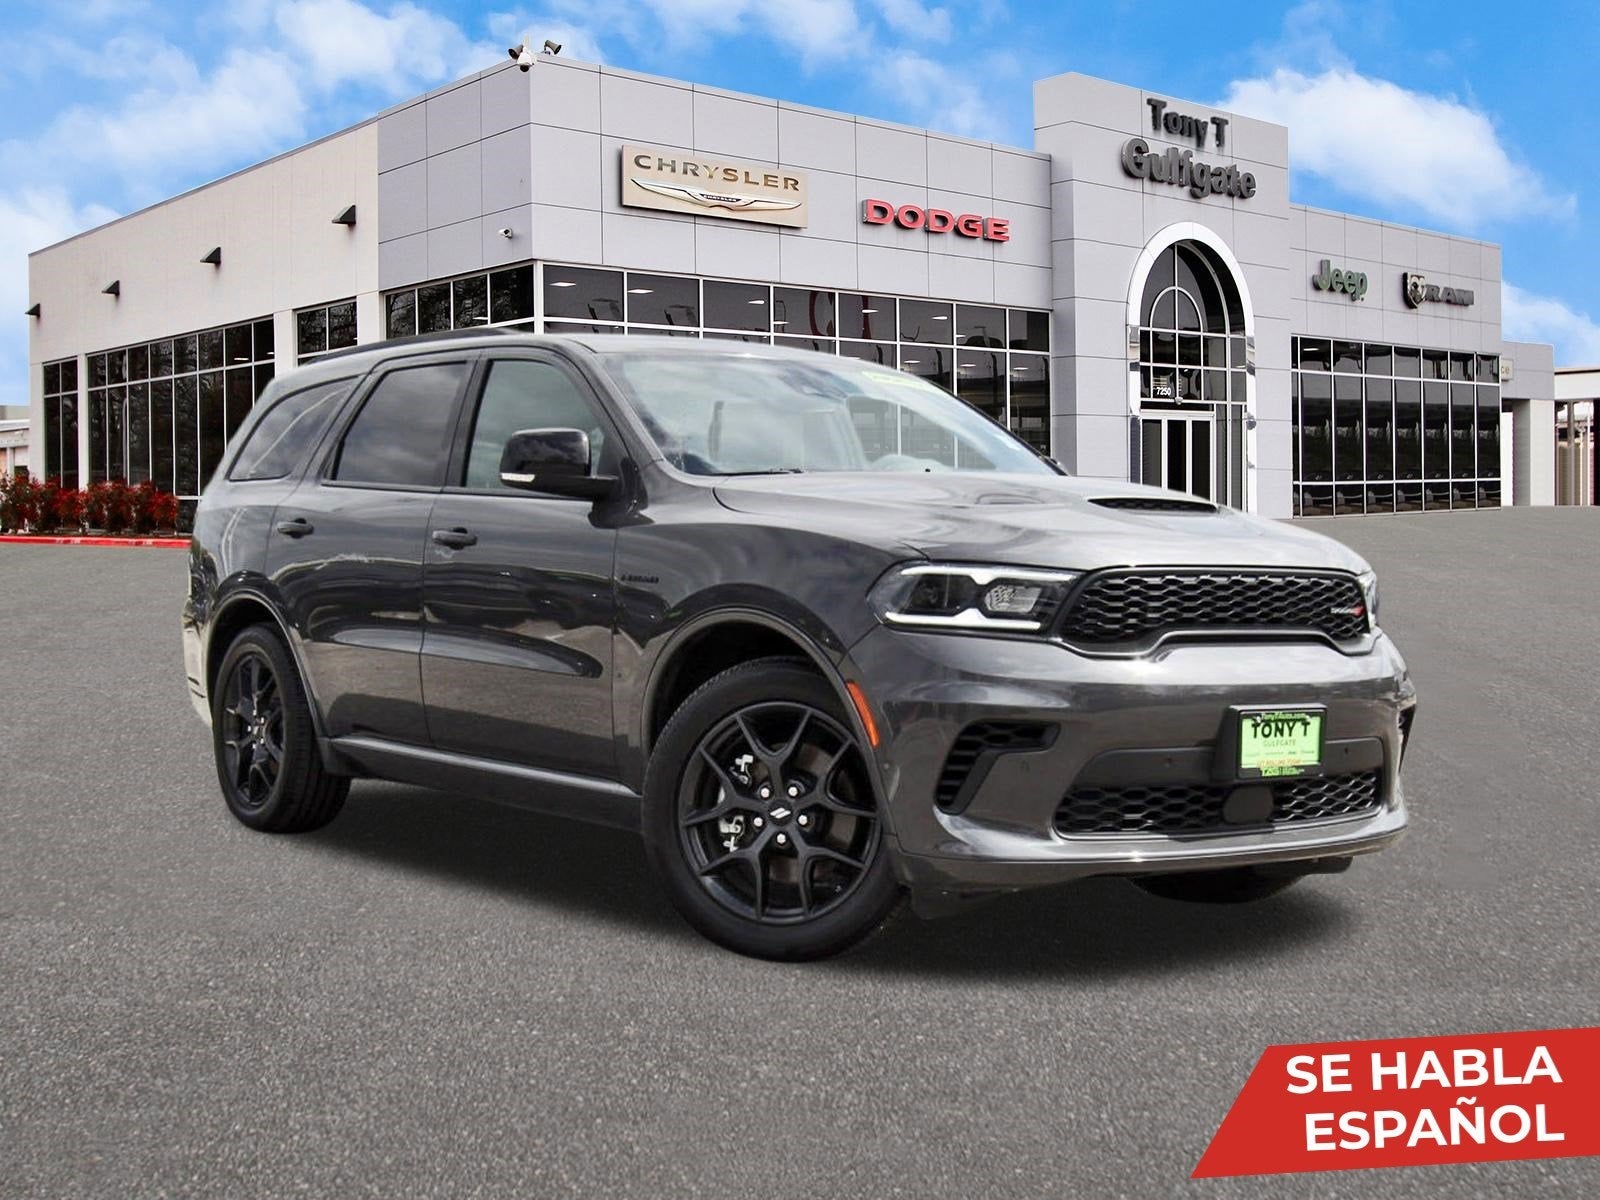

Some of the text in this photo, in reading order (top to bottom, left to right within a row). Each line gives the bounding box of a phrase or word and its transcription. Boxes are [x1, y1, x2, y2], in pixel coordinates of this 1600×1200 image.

[1147, 98, 1229, 147] Tony T
[633, 154, 800, 192] CHRYSLER
[1121, 138, 1257, 199] Gulfgate
[863, 198, 1011, 242] DODGE
[1312, 259, 1368, 302] Jeep
[1424, 284, 1475, 307] RAM
[1156, 386, 1172, 396] 7250
[1251, 720, 1310, 738] TONY T
